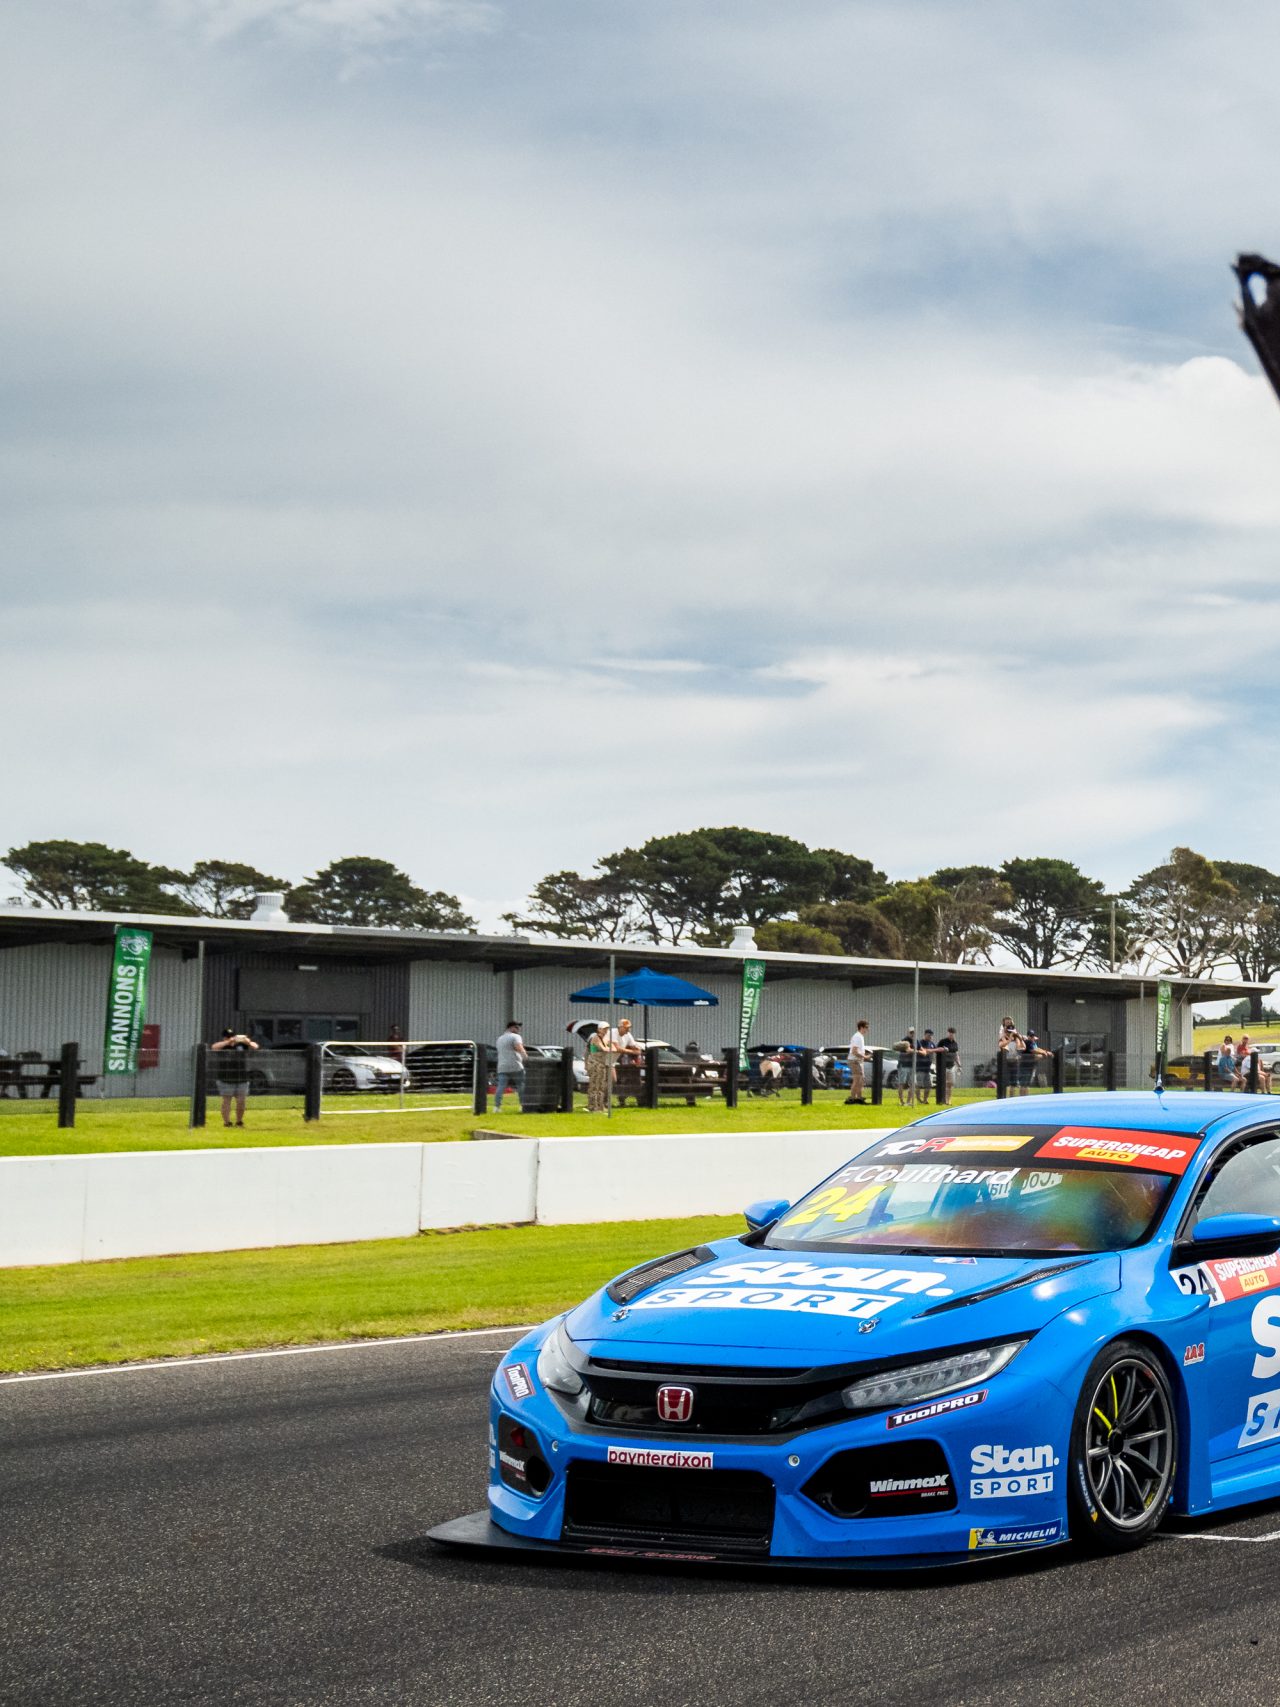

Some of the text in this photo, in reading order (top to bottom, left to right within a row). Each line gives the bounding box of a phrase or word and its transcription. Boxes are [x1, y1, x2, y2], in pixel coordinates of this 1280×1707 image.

[108, 965, 137, 1071] SHANNONS
[874, 1136, 956, 1157] TCR
[1053, 1136, 1187, 1160] SUPERCHEAP
[1085, 1150, 1129, 1159] AUTO
[829, 1165, 1021, 1185] F.Coulthard
[782, 1185, 887, 1228] 24
[683, 1261, 954, 1296] Stan.
[1214, 1252, 1278, 1281] SUPERCHEAP
[1179, 1268, 1217, 1302] 24
[1244, 1274, 1265, 1287] AUTO
[647, 1291, 887, 1312] SPORT
[507, 1365, 530, 1397] ToolPRO
[893, 1394, 979, 1425] ToolPRO
[608, 1450, 711, 1468] paynterdixon
[971, 1444, 1060, 1474] Stan.
[973, 1476, 1052, 1495] SPORT
[999, 1526, 1057, 1542] MICHELIN
